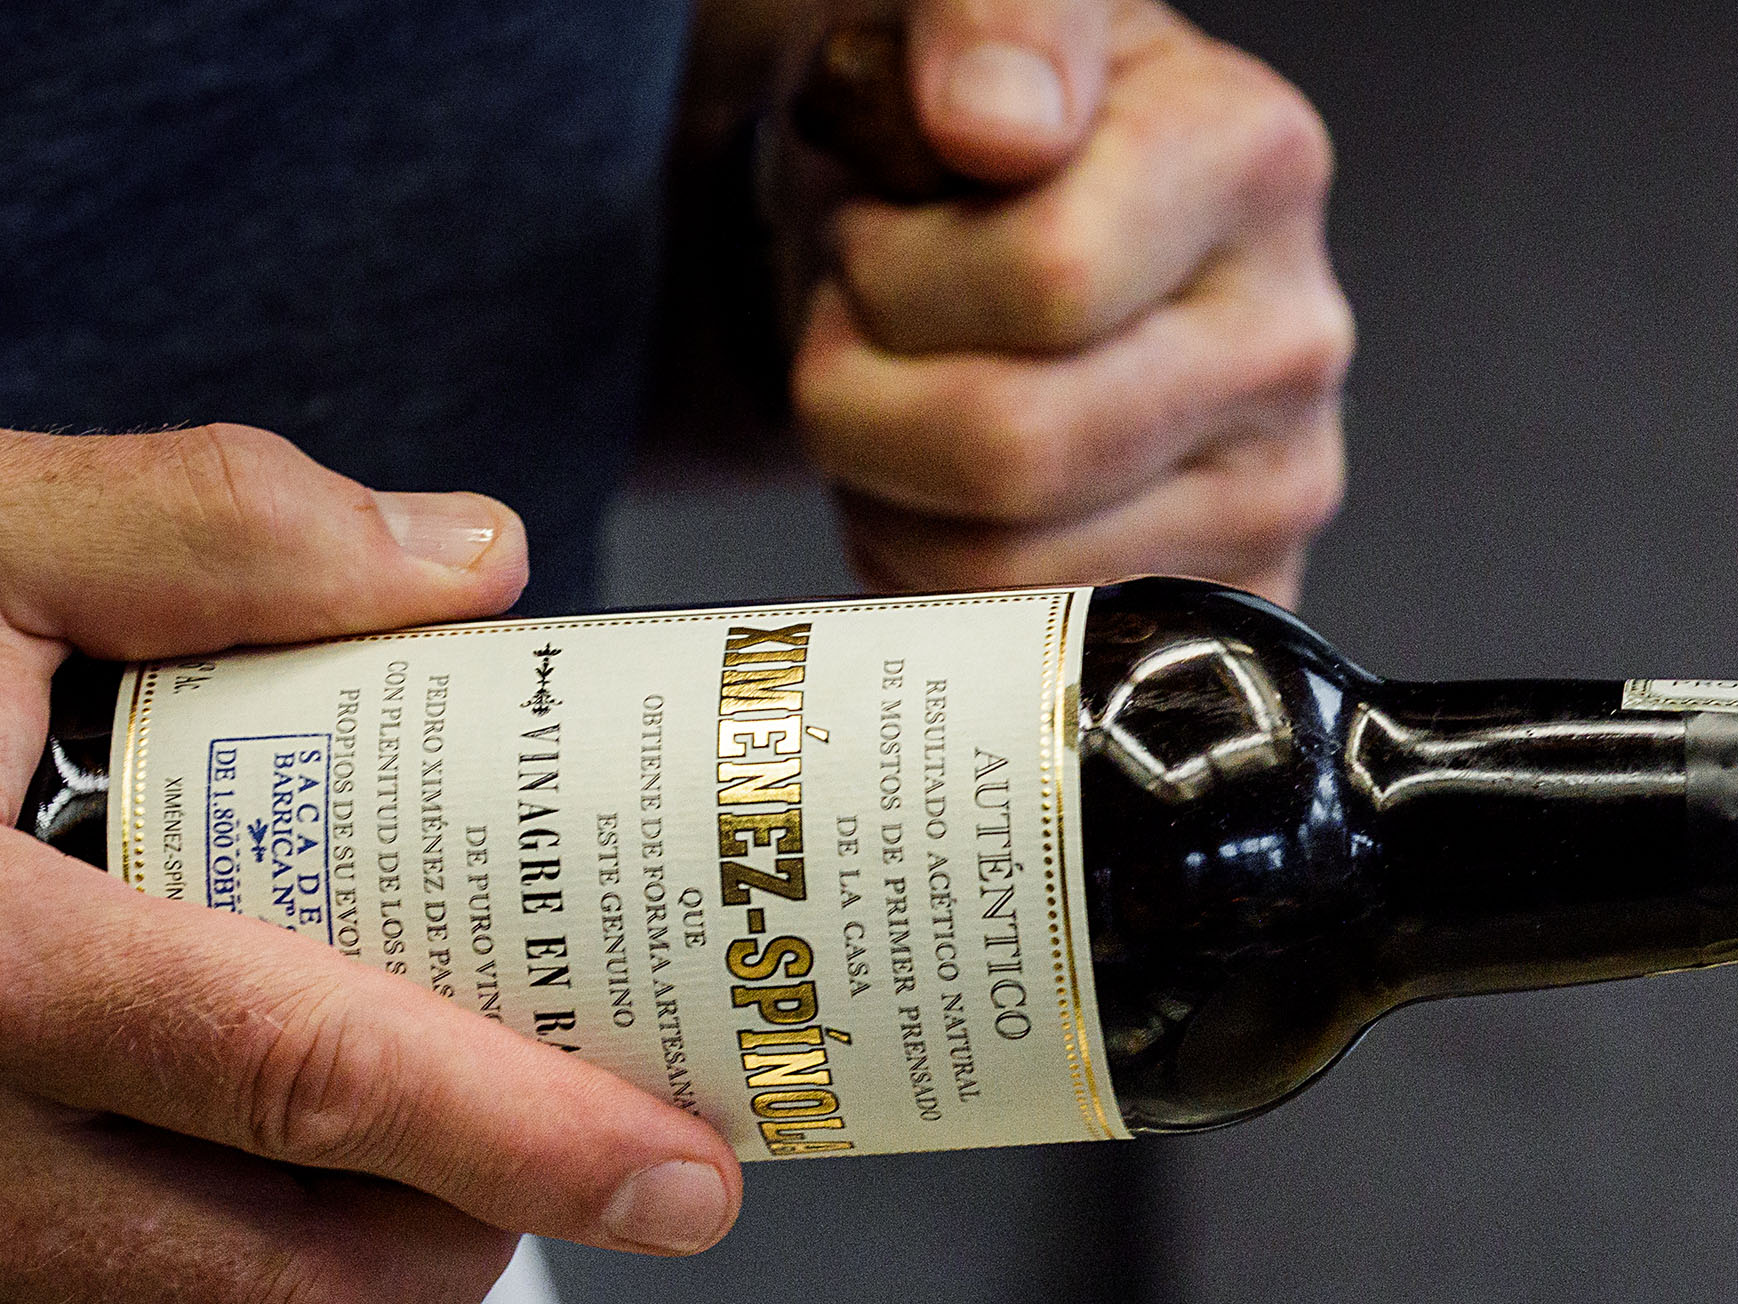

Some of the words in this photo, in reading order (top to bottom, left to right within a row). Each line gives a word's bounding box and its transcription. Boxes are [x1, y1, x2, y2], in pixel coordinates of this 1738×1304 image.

[383, 660, 409, 702] CON
[422, 673, 450, 754] PEDRO
[881, 658, 904, 691] DE
[213, 748, 238, 783] DE
[333, 688, 361, 794] PROPIOS
[376, 707, 402, 845] PLENITUD
[641, 693, 664, 811] OBTIENE
[880, 699, 902, 811] MOSTOS
[924, 679, 947, 840] RESULTADO
[212, 789, 235, 849] 1.800
[271, 752, 296, 880] BARRICA
[296, 749, 322, 856] SACA
[332, 800, 354, 840] DE
[421, 758, 449, 894] XIMÉNEZ
[518, 723, 564, 914] VINAGRE
[641, 817, 664, 860] DE
[836, 815, 858, 857] DE
[333, 845, 355, 882] SU
[378, 851, 401, 894] DE
[466, 825, 489, 867] DE
[597, 812, 621, 887] ESTE
[881, 823, 904, 865] DE
[296, 872, 323, 926] DE
[380, 899, 405, 955] LOS
[424, 899, 449, 942] DE
[468, 873, 495, 956] PURO
[642, 865, 671, 974] FORMA
[677, 886, 706, 948] QUE
[716, 622, 854, 1156] XIMÉNEZ-SPÍNOLA
[838, 869, 861, 909] LA
[927, 851, 960, 982] ACÉTICO
[974, 747, 1032, 1040] AUTÉNTICO
[525, 935, 573, 988] EN
[600, 891, 635, 1028] GENUINO
[843, 921, 871, 998] CASA
[884, 877, 916, 995] PRIMER
[652, 977, 700, 1116] ARTESANA
[898, 1005, 943, 1121] PRENSADO
[941, 992, 981, 1102] NATURAL
